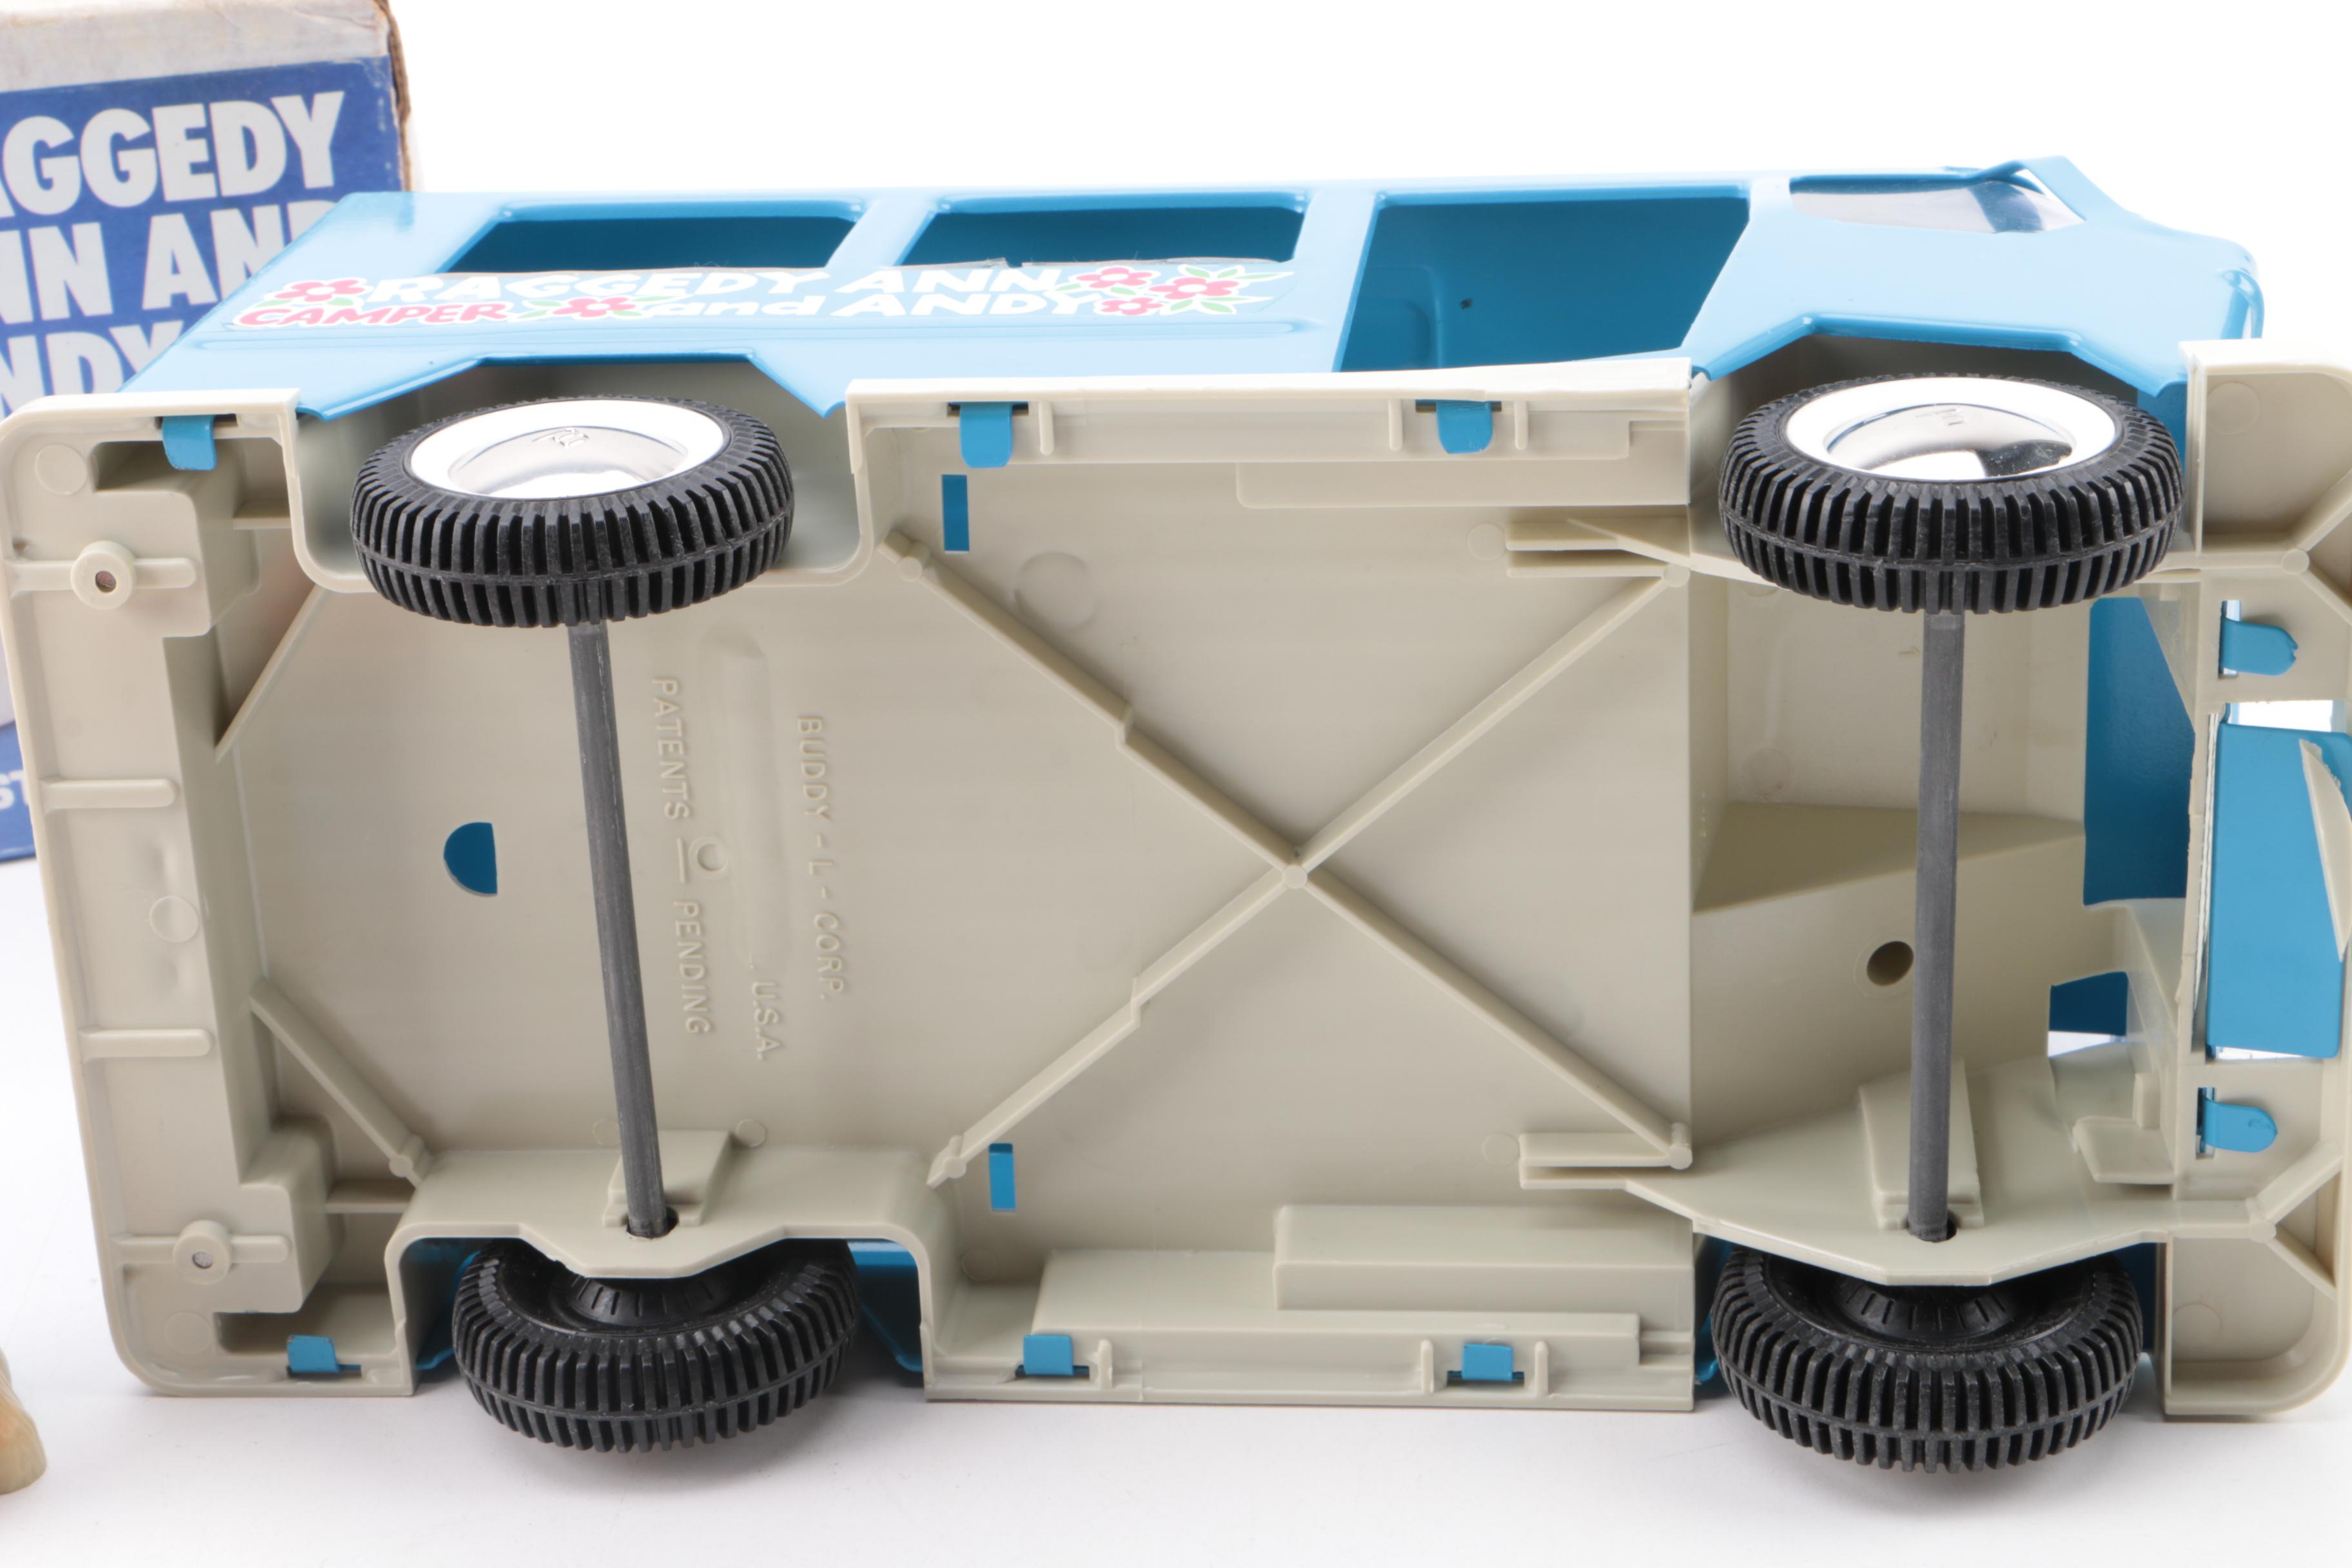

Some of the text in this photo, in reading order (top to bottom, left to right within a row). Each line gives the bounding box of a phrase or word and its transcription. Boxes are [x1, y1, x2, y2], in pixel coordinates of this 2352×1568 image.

[0, 92, 344, 217] GGEDY
[142, 201, 337, 309] AN
[366, 269, 1061, 302] RAGGEDY ANN
[239, 303, 508, 326] CAMPER
[645, 293, 1101, 317] and ANDY
[797, 716, 830, 821] BUDDY
[652, 676, 710, 1035] PATENTS PENDING
[752, 981, 783, 1059] U.S.A.
